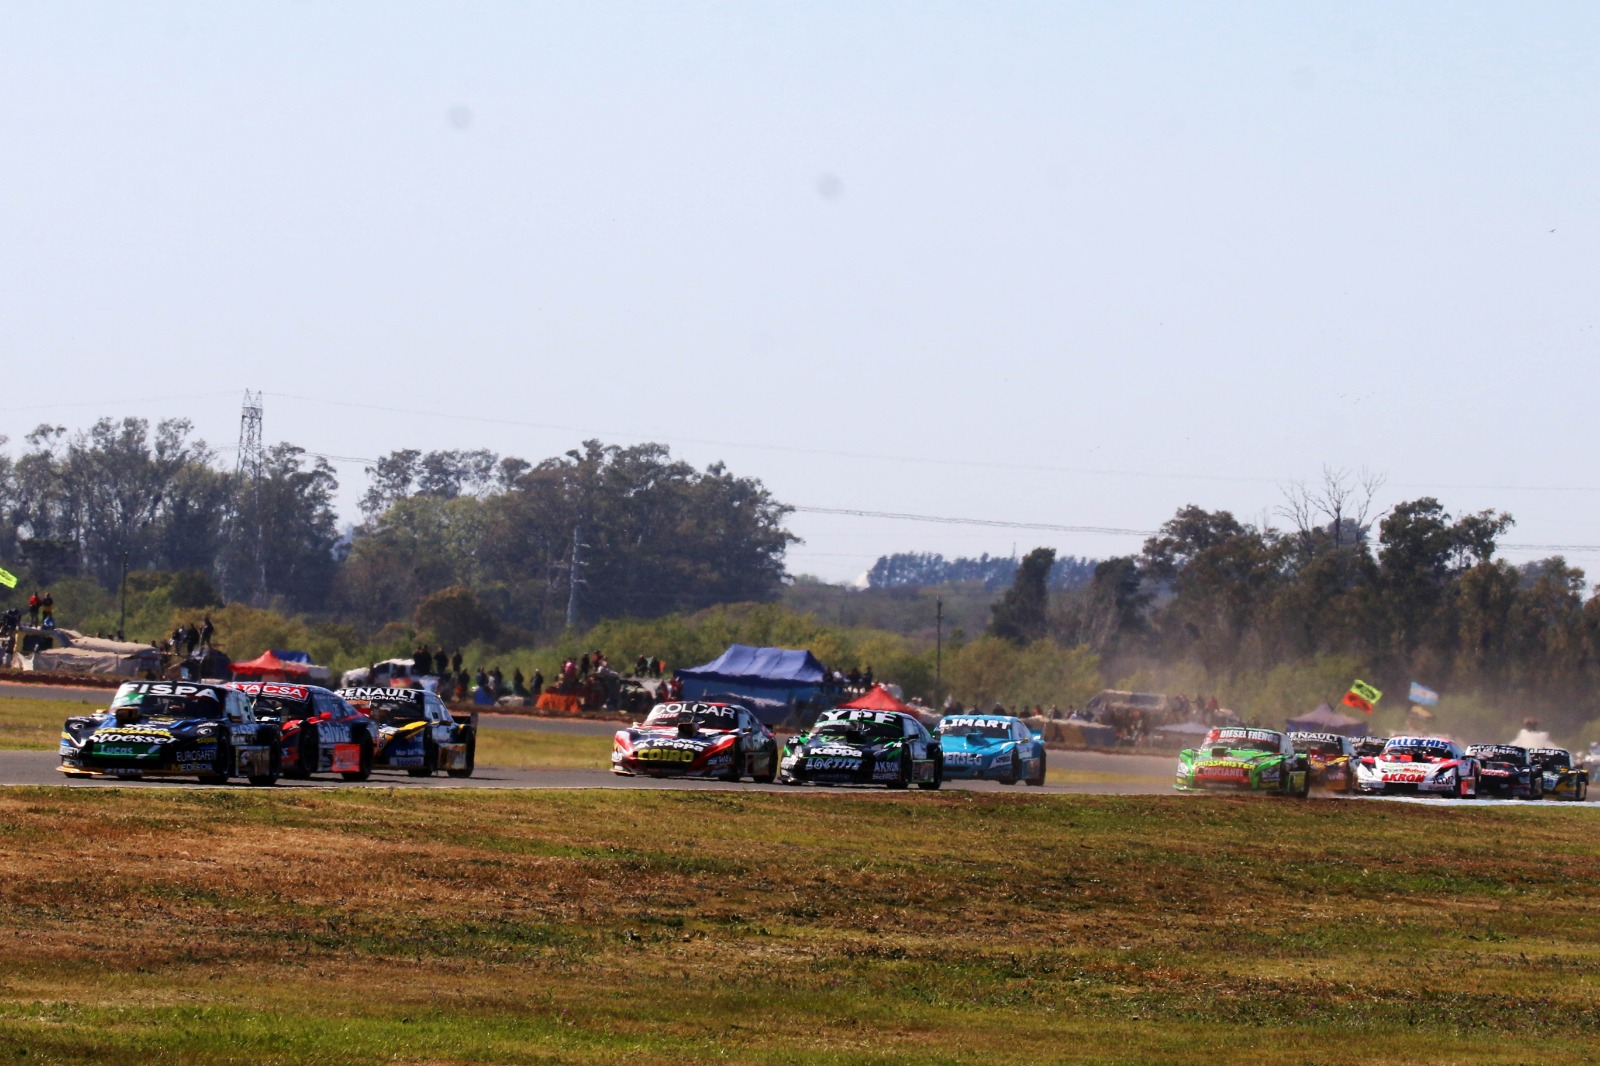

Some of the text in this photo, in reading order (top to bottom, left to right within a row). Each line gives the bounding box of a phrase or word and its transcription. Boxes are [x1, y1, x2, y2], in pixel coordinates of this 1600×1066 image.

[122, 683, 220, 703] FISPA
[333, 687, 417, 699] RENAULT
[650, 703, 736, 719] COLCAR
[822, 710, 898, 723] YPF
[939, 718, 1011, 729] LIMART
[1219, 729, 1247, 739] DIESEL
[1287, 731, 1339, 741] ENAULT
[100, 744, 134, 755] Lucas
[810, 747, 863, 758] Kappa
[637, 748, 695, 763] COIRO
[805, 757, 864, 771] LOCTITE
[1381, 773, 1426, 783] AKRON
